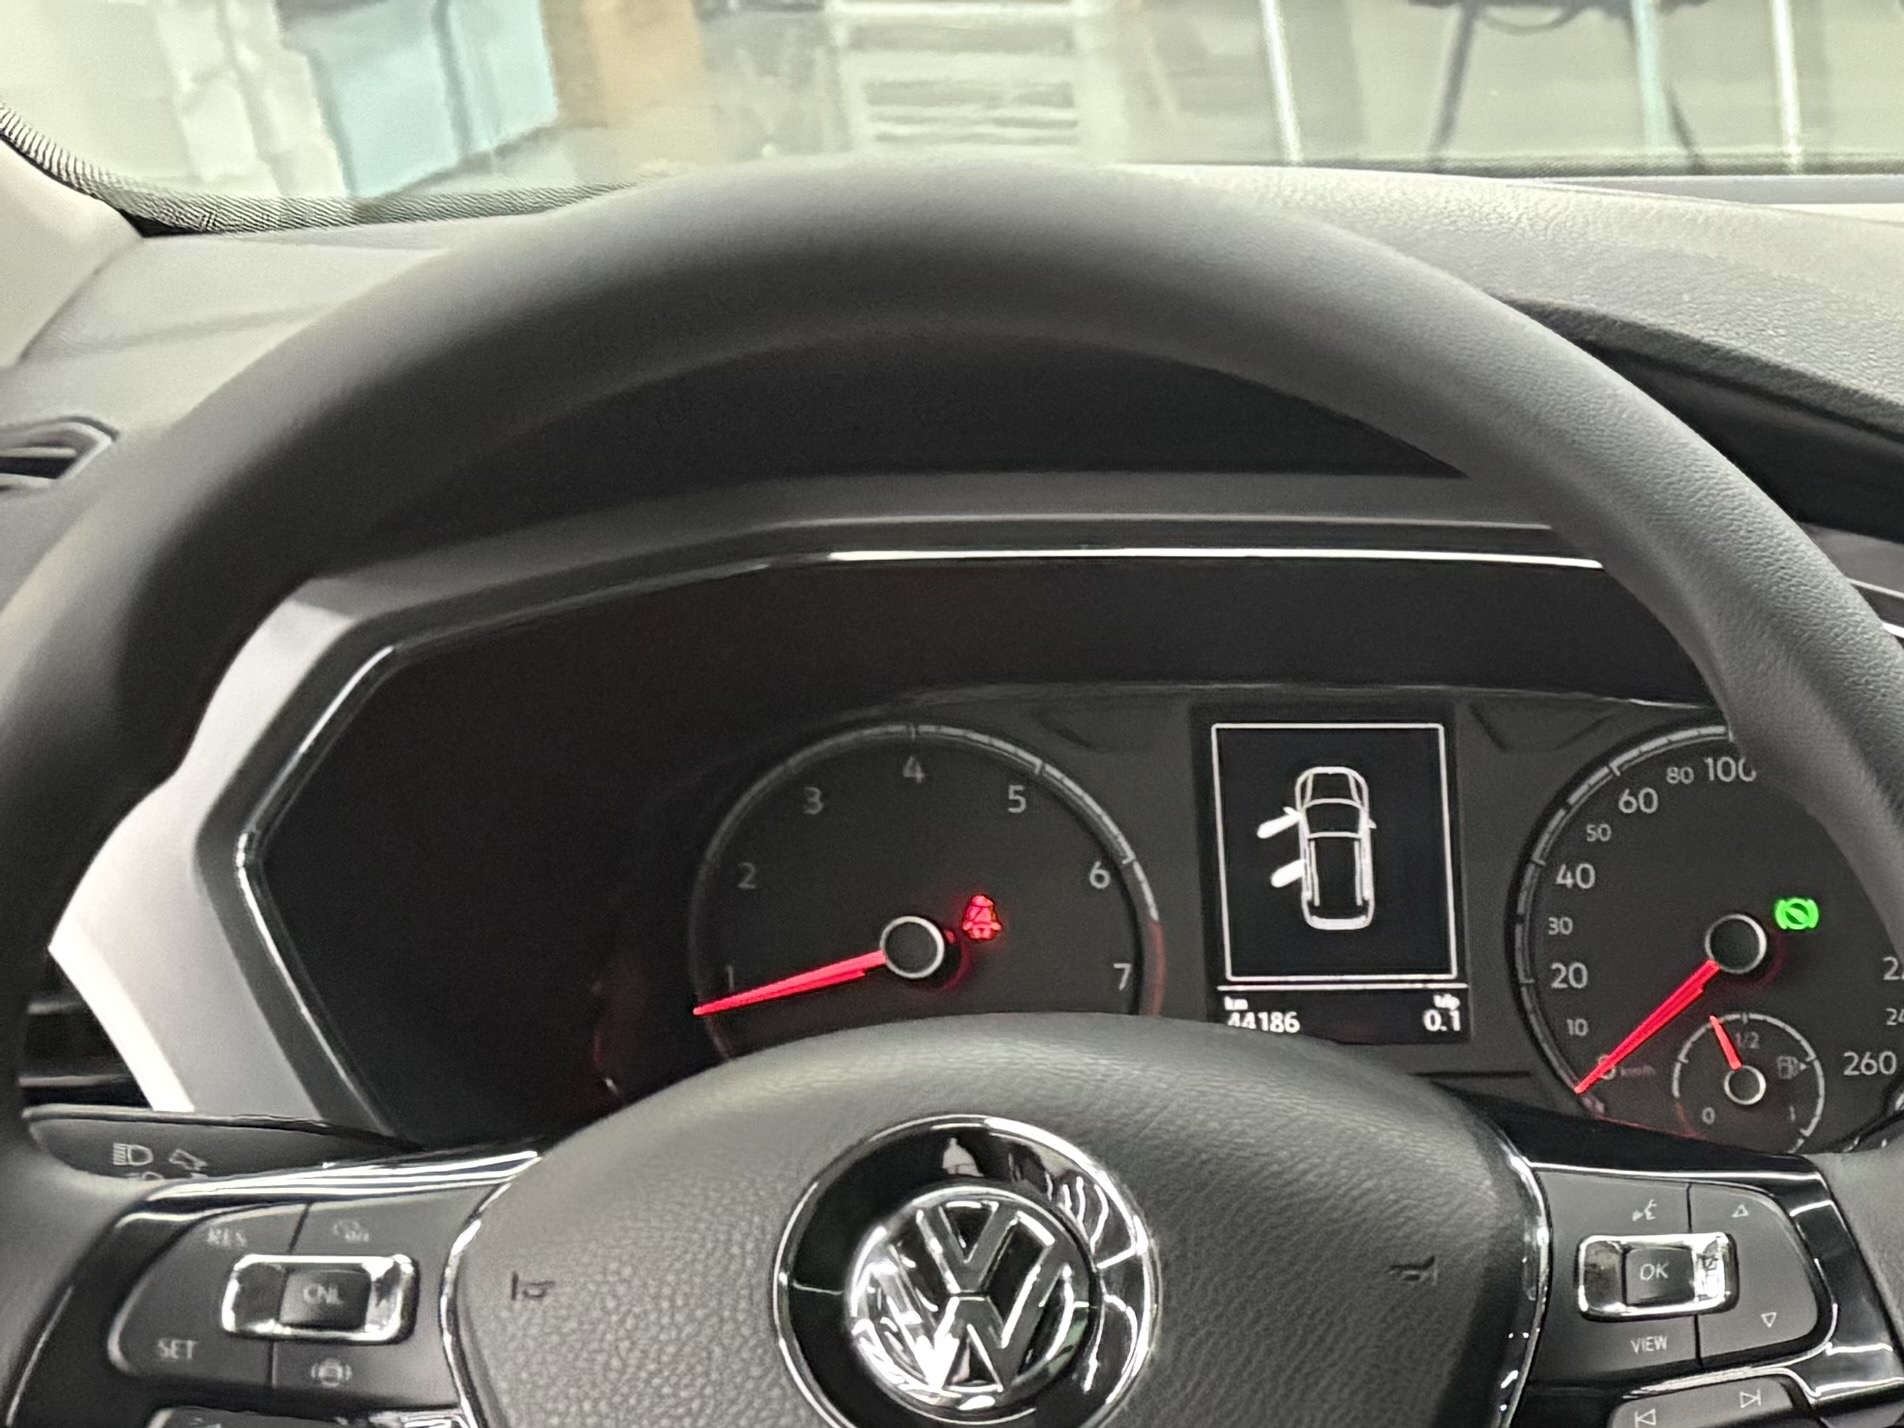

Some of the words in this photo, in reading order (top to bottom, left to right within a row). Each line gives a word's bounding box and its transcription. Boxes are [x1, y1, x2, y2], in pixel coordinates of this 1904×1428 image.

[903, 757, 926, 784] 4
[1665, 766, 1695, 785] 80
[803, 787, 825, 815] 3
[1008, 785, 1027, 813] 5
[1618, 787, 1659, 814] 60
[1586, 823, 1612, 842] 50
[736, 862, 758, 890] 2
[1088, 861, 1112, 889] 6
[1555, 863, 1596, 889] 40
[1547, 917, 1574, 935] 30
[1113, 962, 1133, 991] 7
[1550, 962, 1589, 989] 20
[1226, 1011, 1301, 1033] 44186
[1423, 1008, 1462, 1032] 0.1
[1566, 1019, 1589, 1036] 10
[1735, 1032, 1760, 1049] 1/2
[1843, 1051, 1898, 1076] 260
[1702, 1106, 1716, 1125] 0
[1640, 1262, 1670, 1281] OK
[157, 1338, 198, 1361] SET
[1630, 1335, 1668, 1354] VIEW
